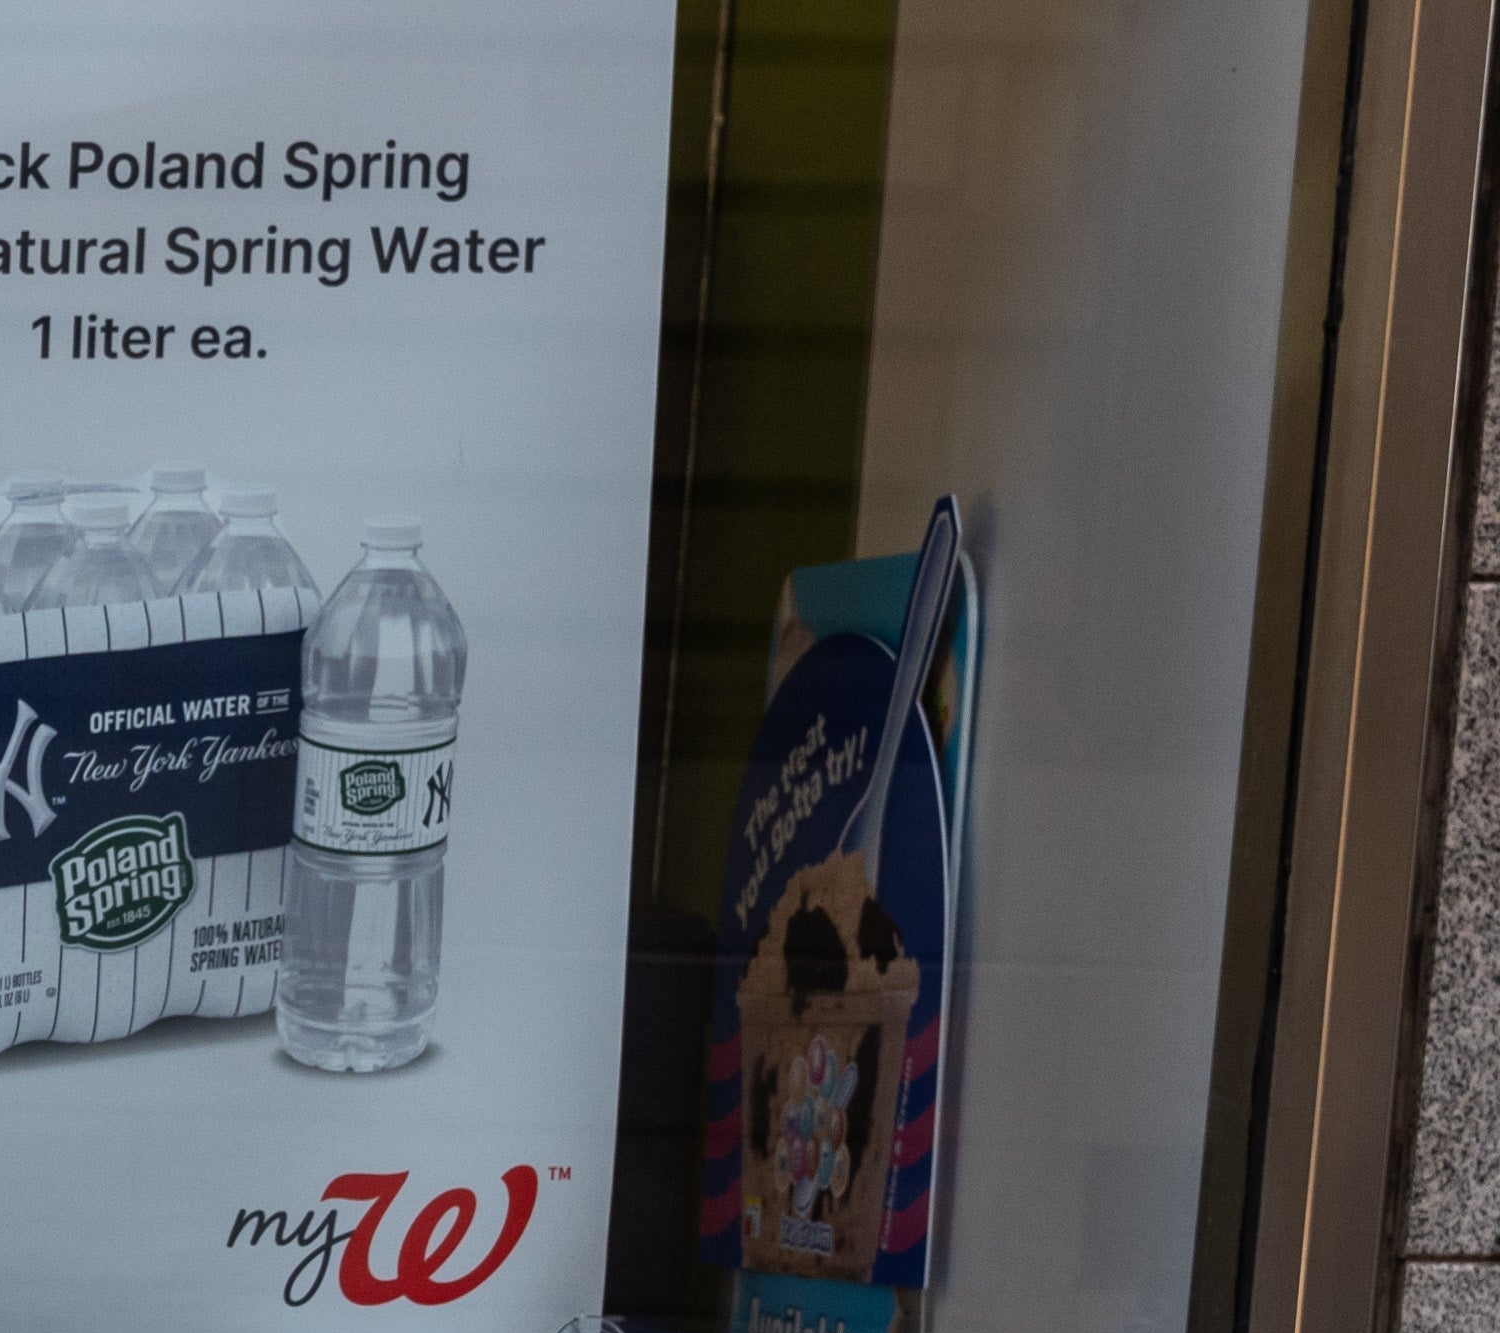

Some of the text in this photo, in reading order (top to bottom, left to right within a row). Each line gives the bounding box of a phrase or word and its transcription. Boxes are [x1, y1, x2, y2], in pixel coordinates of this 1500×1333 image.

[68, 142, 265, 190] Poland
[283, 140, 471, 202] Spring
[164, 227, 352, 288] Spring
[370, 227, 546, 275] Water
[31, 315, 269, 360] 1 liter ea.
[90, 693, 290, 734] OFFICIAL WATER OF THE
[63, 727, 300, 793] New York Yankees
[345, 767, 397, 789] Poland
[744, 713, 827, 852] The treat
[345, 783, 398, 806] Spring
[736, 725, 869, 931] you gotta try!
[58, 824, 182, 896] Poland
[62, 862, 187, 946] Spring
[122, 904, 152, 926] 1845
[190, 939, 283, 974] SPRING WATE
[191, 914, 287, 950] 100% NATURA
